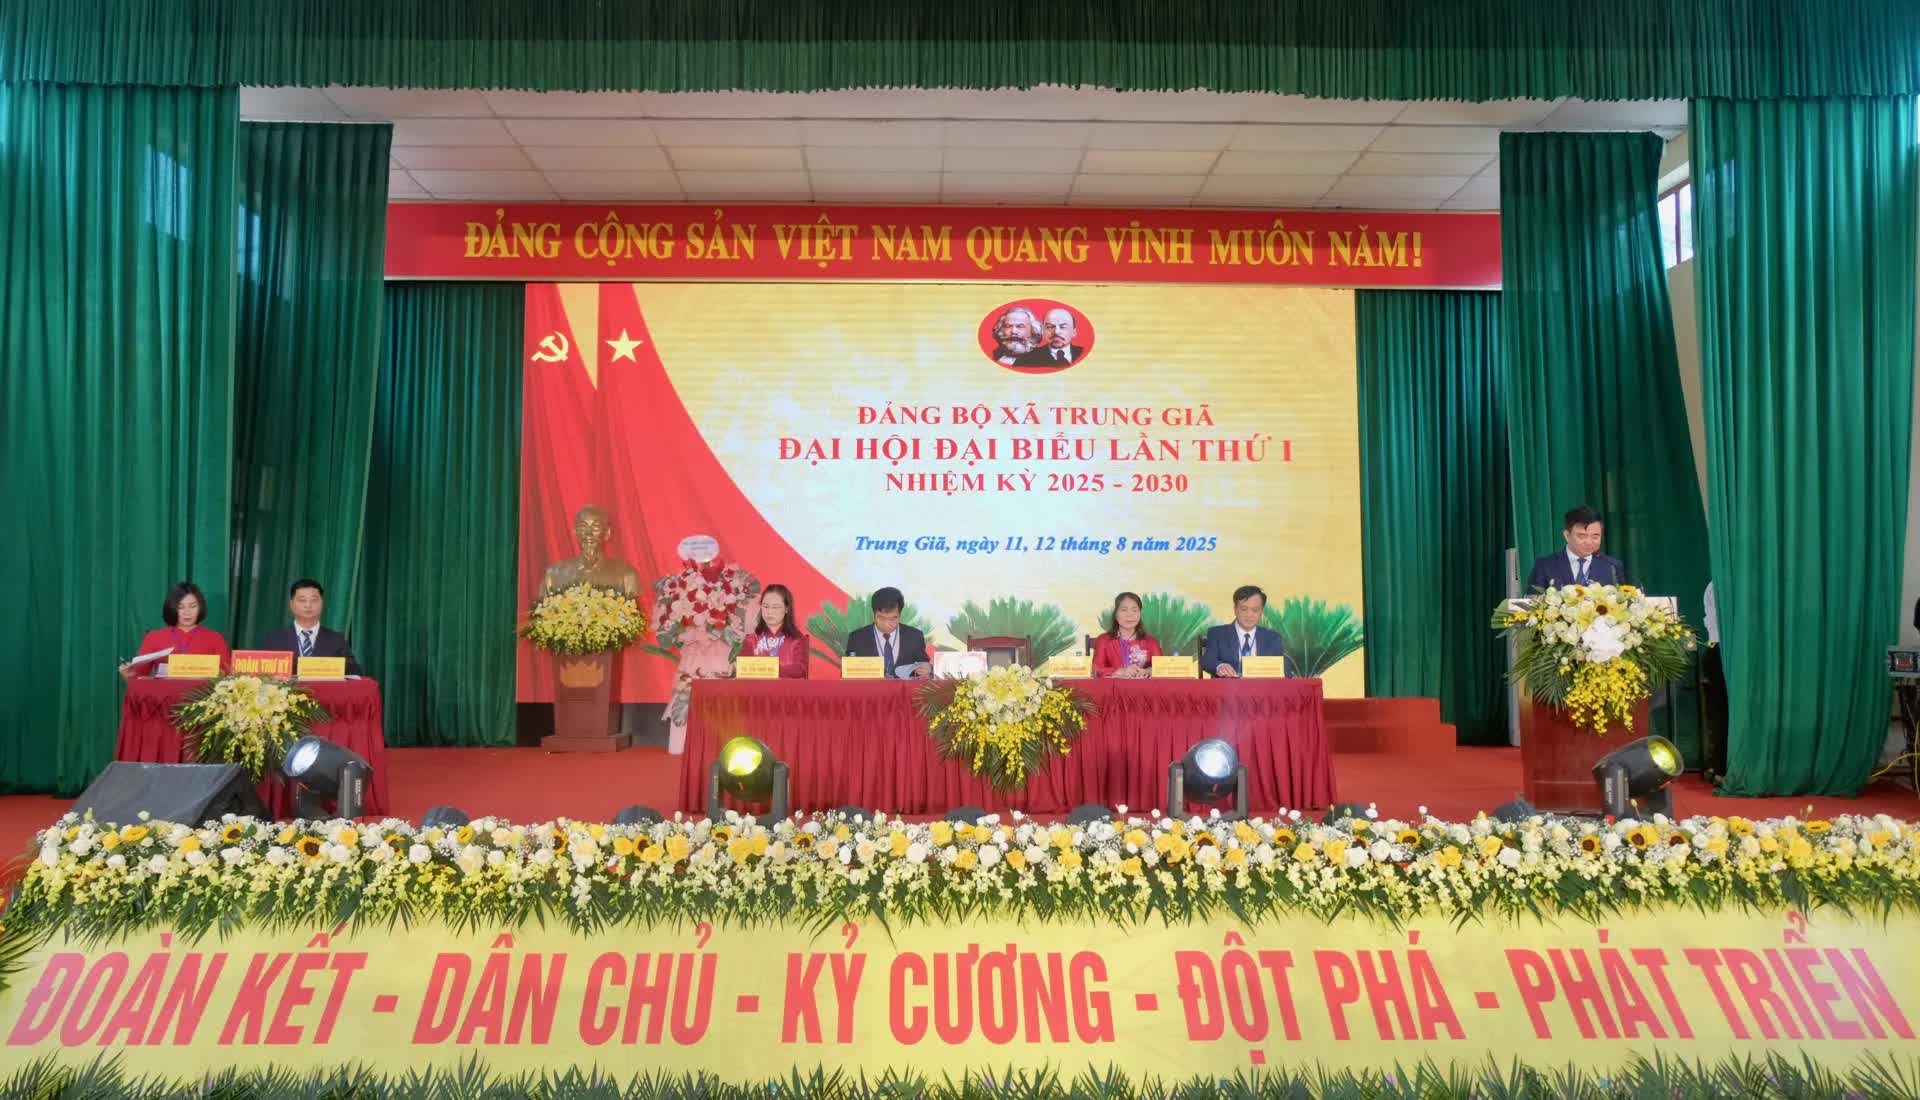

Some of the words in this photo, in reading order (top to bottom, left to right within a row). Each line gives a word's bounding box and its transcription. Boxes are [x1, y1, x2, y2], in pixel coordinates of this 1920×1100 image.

[464, 209, 562, 258] ĐẢNG
[574, 210, 675, 266] CỘNG
[686, 209, 755, 260] SẢN
[773, 213, 858, 269] VIỆT
[872, 225, 952, 263] NAM
[966, 227, 1089, 271] QUANG
[1209, 220, 1313, 266] MUÔN
[1328, 225, 1422, 268] NĂM!
[858, 402, 941, 425] ĐẢNG
[952, 404, 991, 429] BỘ
[1000, 403, 1040, 425] XÃ
[1050, 406, 1153, 426] TRUNG
[1162, 404, 1214, 426] GIÃ
[779, 437, 840, 466] ĐẠI
[855, 433, 920, 466] HỘI
[935, 437, 997, 466] ĐẠI
[1012, 432, 1095, 461] BIỂU
[1111, 433, 1180, 461] LẦN
[1192, 432, 1273, 462] THỨ
[1281, 439, 1294, 462] I
[885, 472, 985, 496] NHIỆM
[997, 469, 1035, 492] KỲ
[1048, 474, 1105, 492] 2025
[1133, 474, 1188, 492] 2030
[855, 535, 909, 554] Trung
[914, 536, 952, 552] Giã,
[956, 537, 998, 554] ngày
[1006, 535, 1028, 552] 11,
[1036, 535, 1056, 552] 12
[1060, 535, 1113, 555] tháng
[1116, 536, 1127, 551] 8
[1132, 538, 1169, 551] năm
[1176, 536, 1216, 551] 2025
[217, 924, 369, 1046] KẾT
[412, 933, 567, 1045] DÂN
[579, 922, 718, 1046] CHỦ
[782, 922, 867, 1044] KỶ
[889, 944, 1115, 1045] CƯƠNG
[1175, 930, 1302, 1065] ĐỘT
[1314, 930, 1465, 1040] PHÁ
[1505, 928, 1695, 1040] PHÁT
[1687, 911, 1916, 1040] TRIỂN
